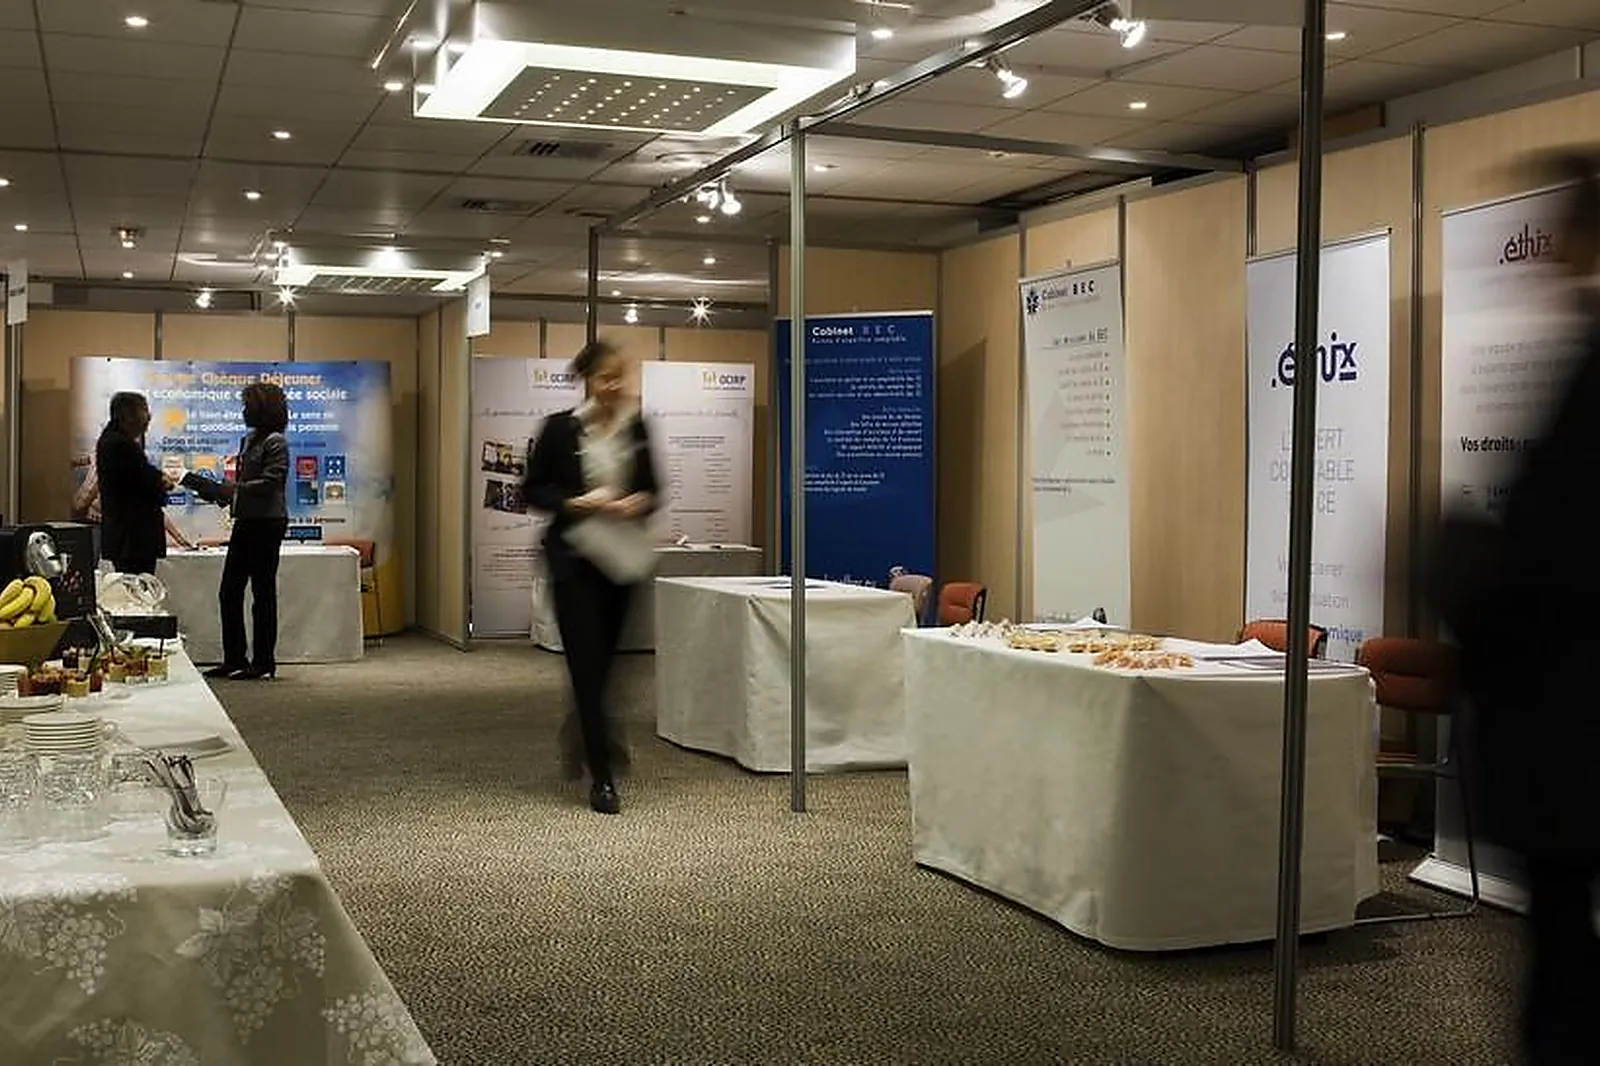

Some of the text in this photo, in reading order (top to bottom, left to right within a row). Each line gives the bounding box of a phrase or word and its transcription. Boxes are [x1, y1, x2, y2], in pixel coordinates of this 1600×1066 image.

[1271, 331, 1357, 388] .éix
[260, 371, 322, 387] Déjeuner
[1461, 436, 1480, 452] Vos
